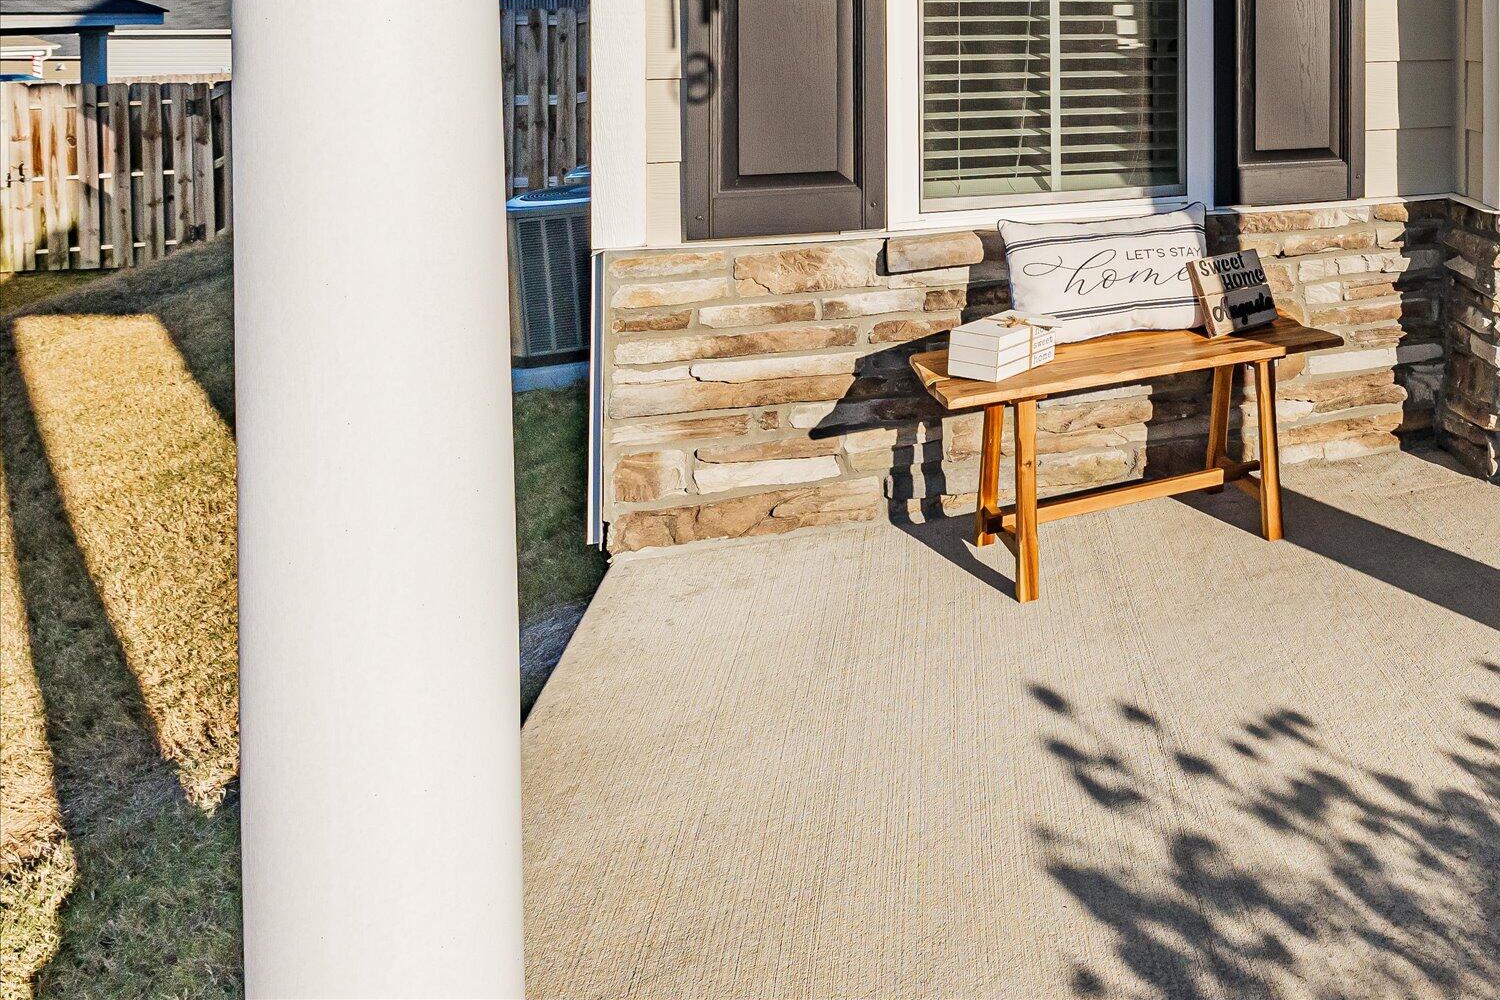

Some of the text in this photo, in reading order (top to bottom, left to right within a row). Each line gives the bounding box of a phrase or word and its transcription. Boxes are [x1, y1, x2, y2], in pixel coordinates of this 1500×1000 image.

[1126, 246, 1201, 261] LET'S STAY
[1198, 252, 1245, 277] Sweet
[1023, 249, 1191, 296] home
[1033, 336, 1053, 350] sweet
[1033, 350, 1052, 365] home
